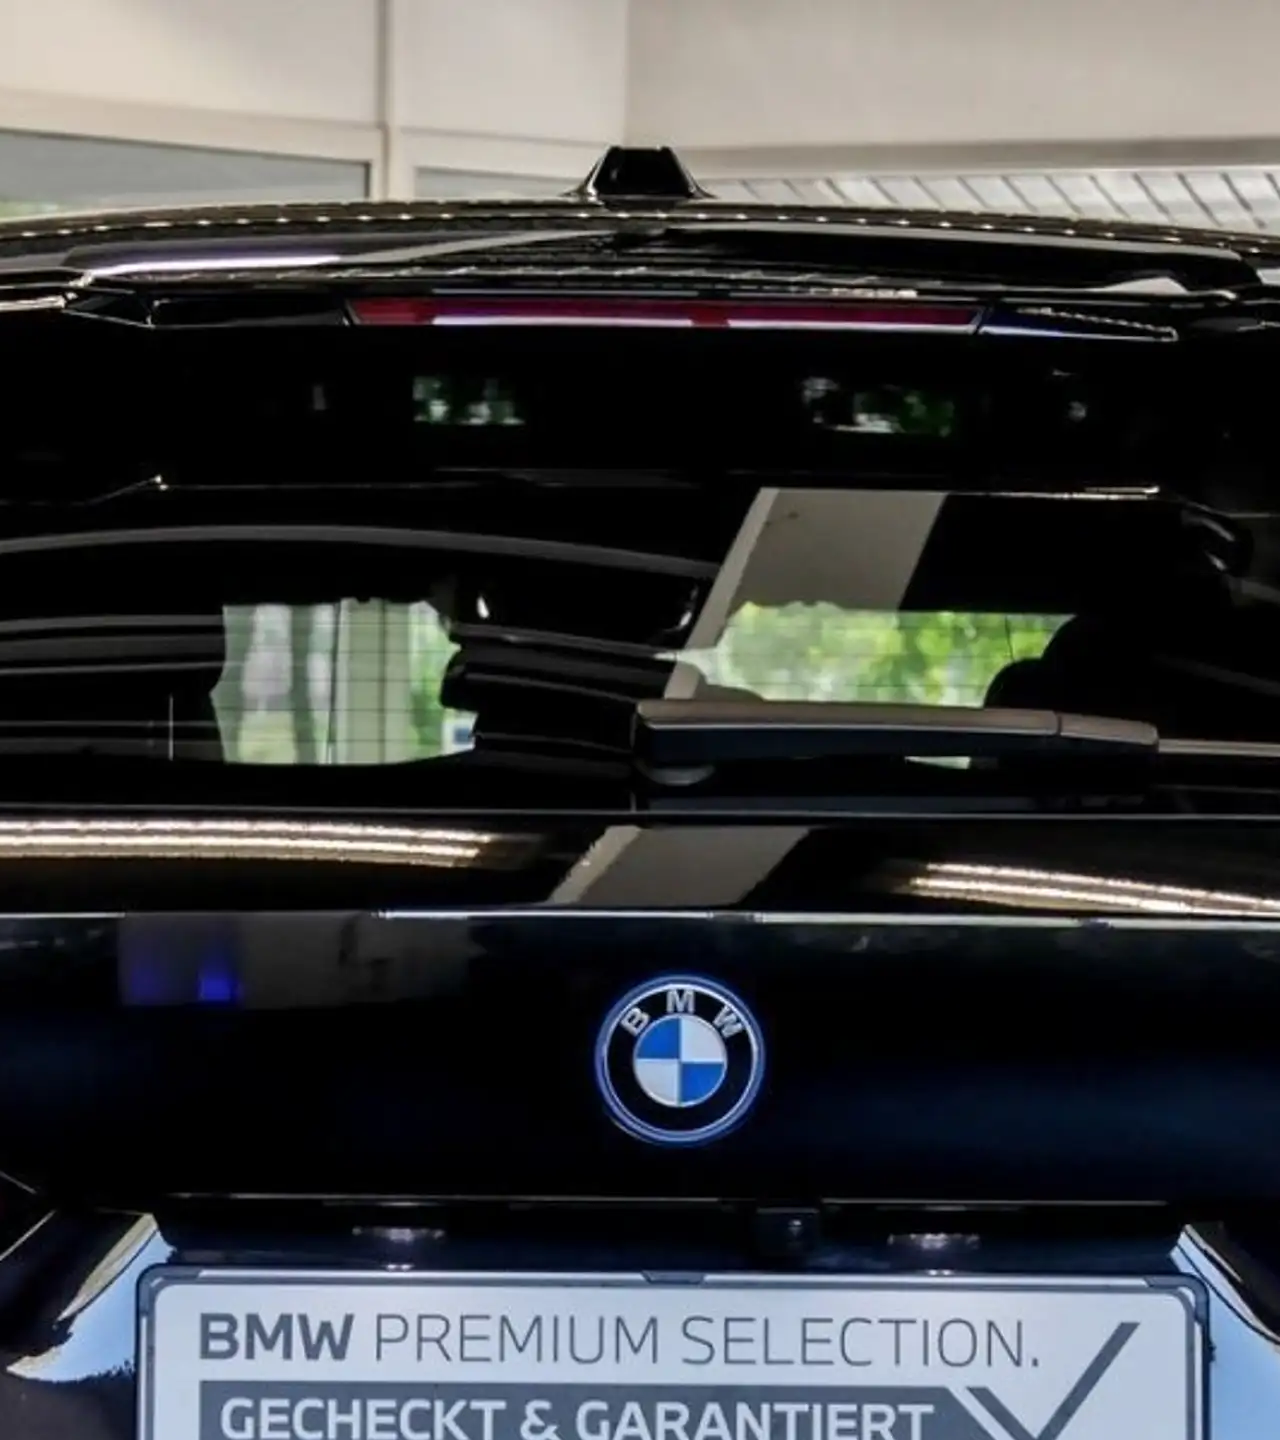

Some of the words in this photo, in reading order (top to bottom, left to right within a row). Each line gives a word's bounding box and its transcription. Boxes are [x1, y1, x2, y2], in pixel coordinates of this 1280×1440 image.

[620, 989, 744, 1039] BMW
[199, 1313, 354, 1361] BMW
[375, 1313, 658, 1364] PREMIUM
[681, 1315, 1039, 1368] SELECTION.
